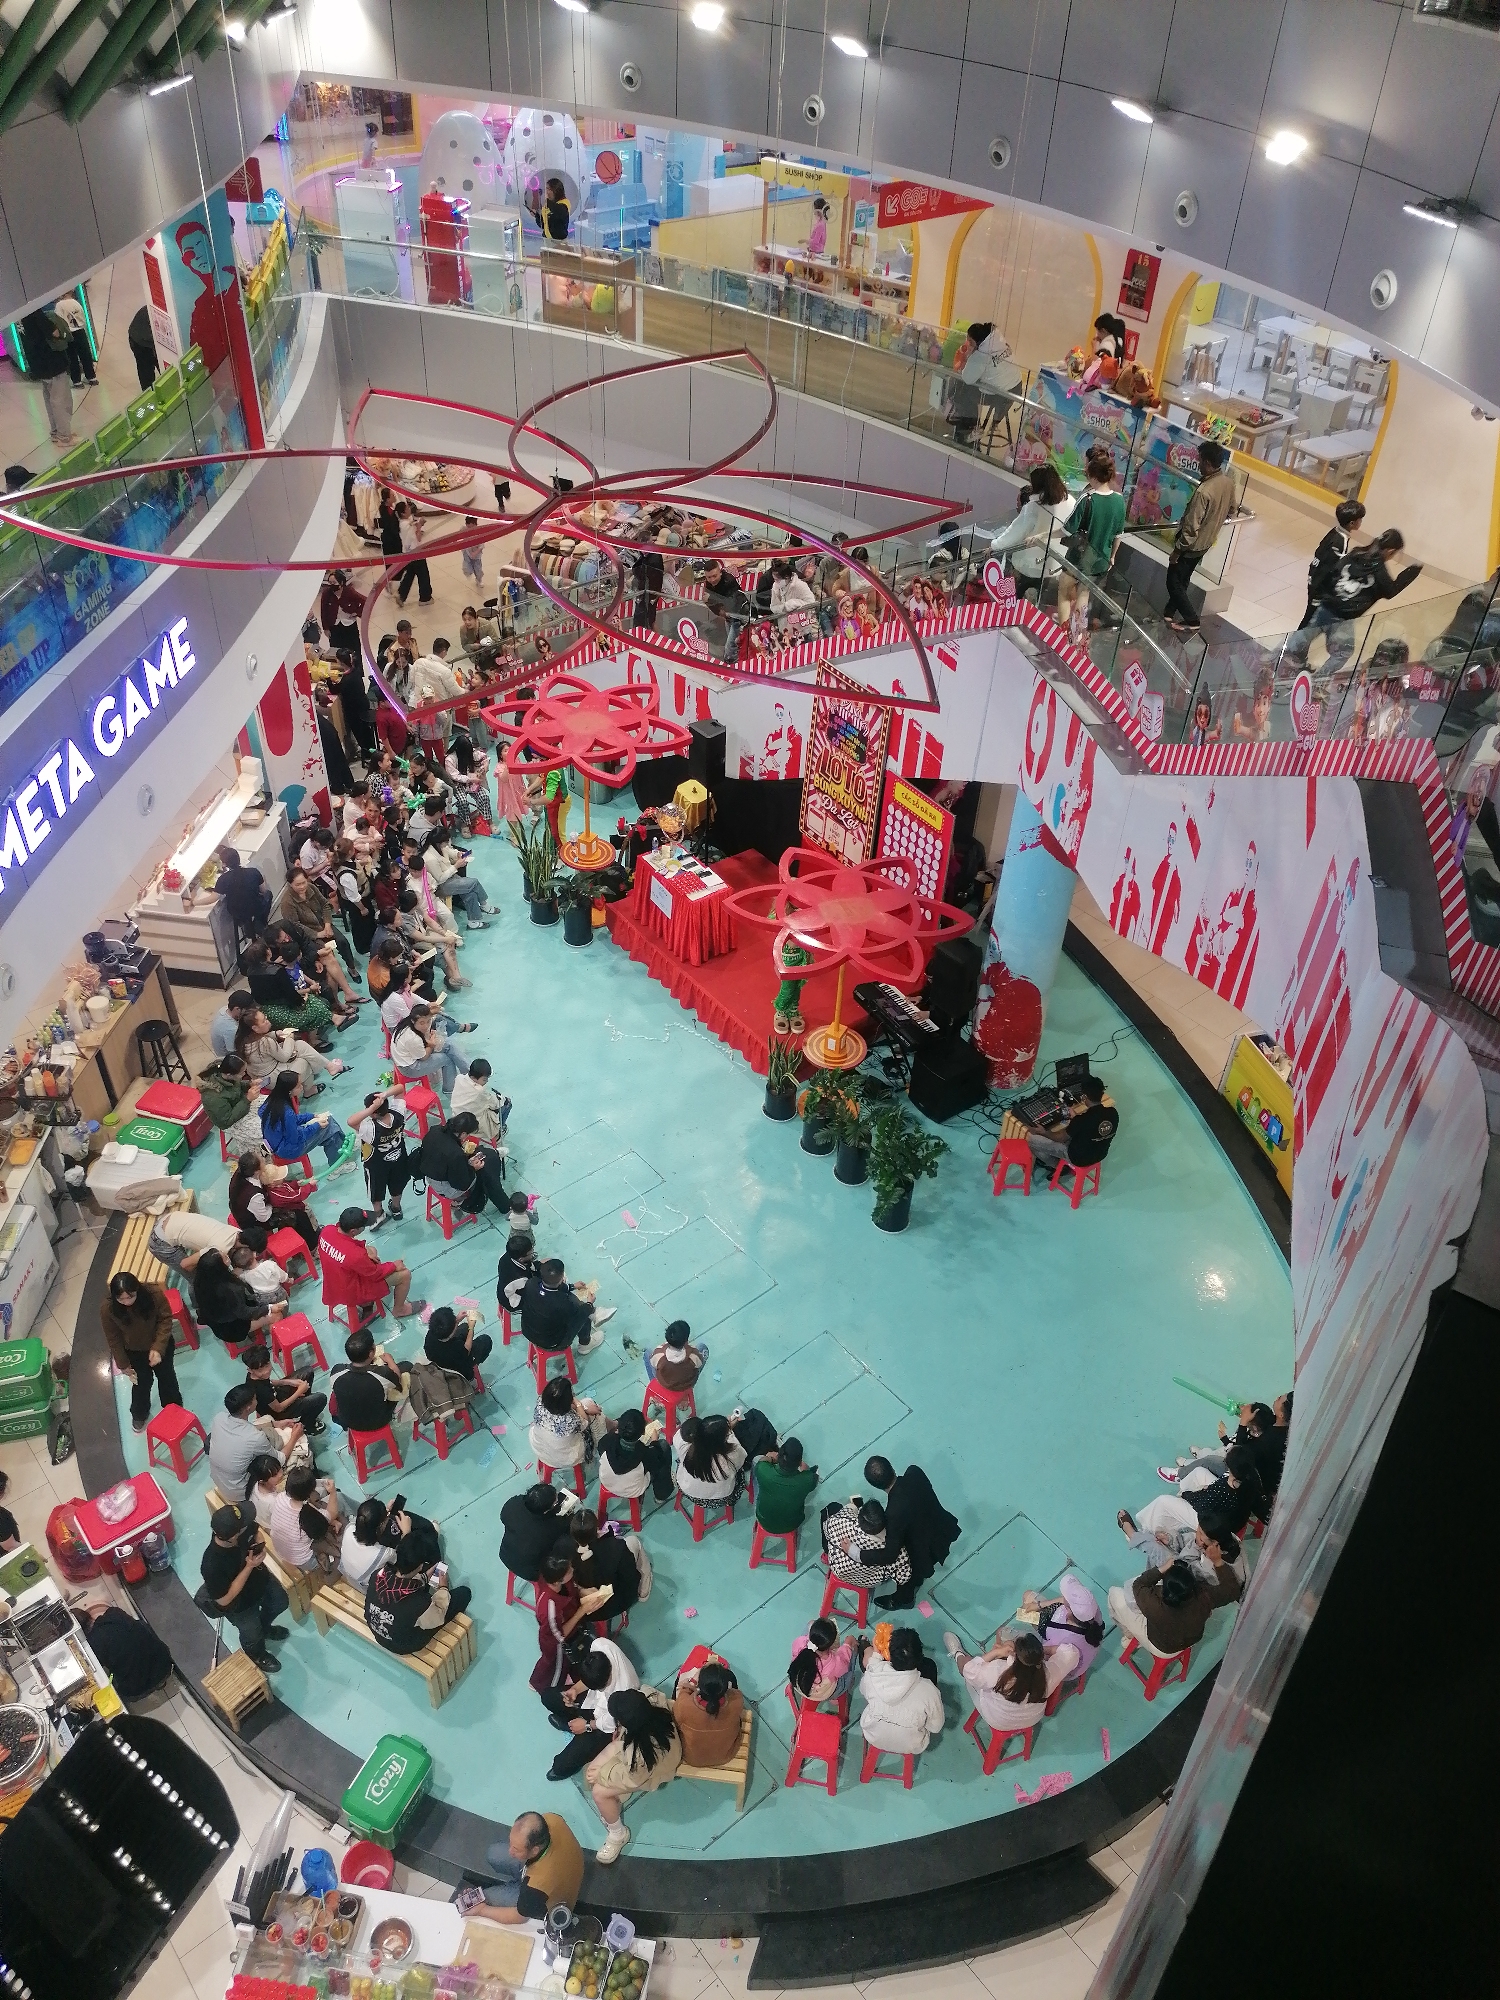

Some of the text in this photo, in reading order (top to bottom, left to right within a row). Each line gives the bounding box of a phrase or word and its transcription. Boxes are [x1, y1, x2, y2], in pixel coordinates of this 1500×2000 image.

[784, 167, 823, 182] SUSHI SHOP
[1090, 416, 1111, 429] SHOP
[74, 582, 113, 622] GAMING
[84, 601, 112, 634] ZONE
[0, 616, 197, 895] META GAME
[135, 1127, 162, 1139] Cozy
[13, 1258, 35, 1304] SANAKY
[371, 1760, 402, 1798] Cozy
